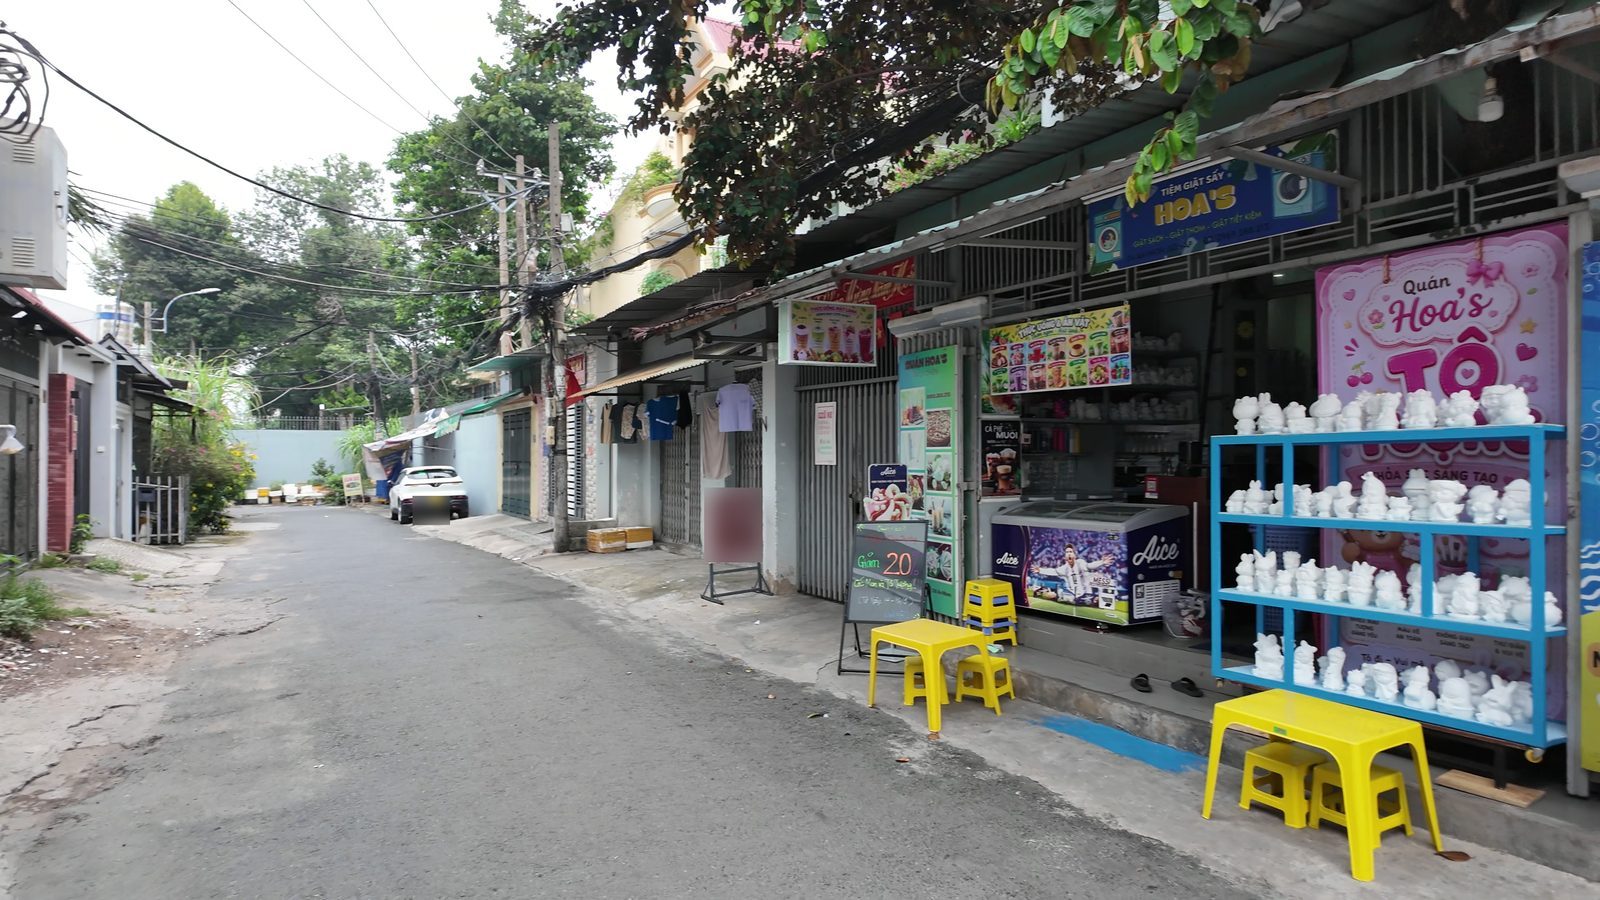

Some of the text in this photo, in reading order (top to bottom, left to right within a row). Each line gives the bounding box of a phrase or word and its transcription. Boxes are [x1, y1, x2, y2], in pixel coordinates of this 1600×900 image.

[1161, 168, 1225, 197] TIỆM GIẶT SẤY
[1154, 184, 1237, 227] HOA'S
[1403, 275, 1451, 295] Quán
[1388, 287, 1493, 334] Hoa's
[925, 353, 948, 367] HOA'S
[1388, 326, 1498, 400] TÔ
[880, 467, 897, 476] Aice
[857, 552, 880, 569] Giảm
[996, 552, 1019, 566] Aice
[1132, 535, 1180, 566] Aice
